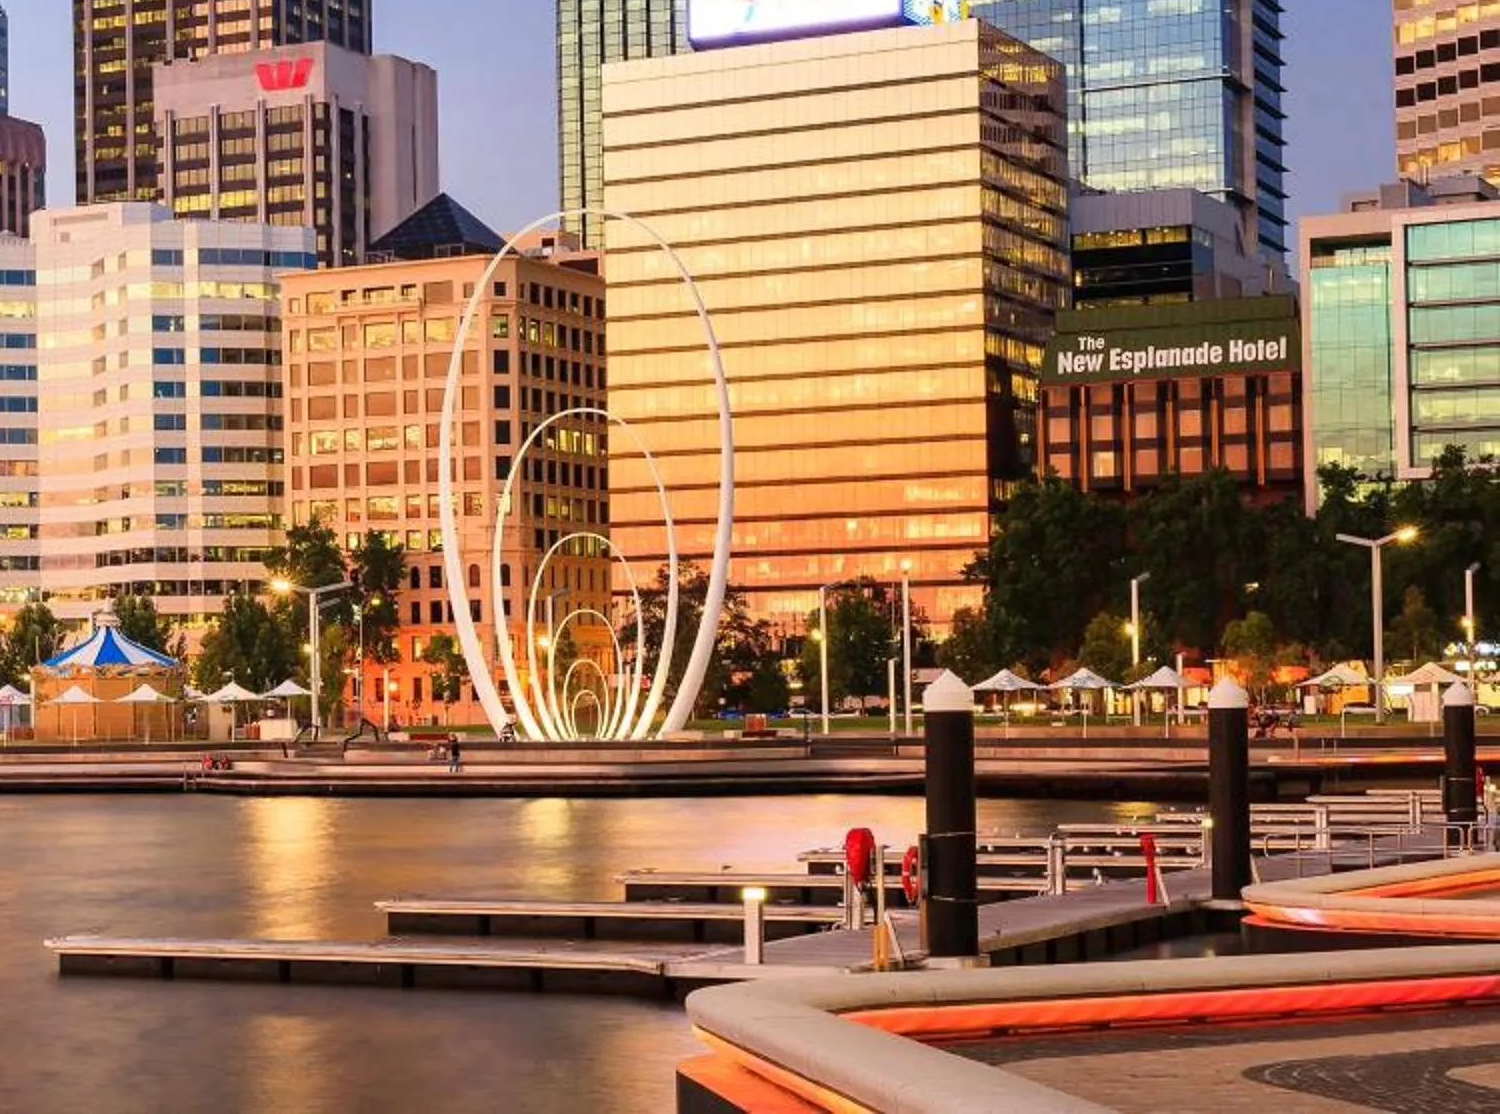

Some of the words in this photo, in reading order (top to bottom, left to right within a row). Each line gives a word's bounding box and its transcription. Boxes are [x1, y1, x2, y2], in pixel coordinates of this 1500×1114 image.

[1057, 351, 1104, 374] New
[1109, 342, 1223, 373] Esplanade
[1229, 337, 1287, 362] Hotel
[1078, 336, 1105, 350] The
